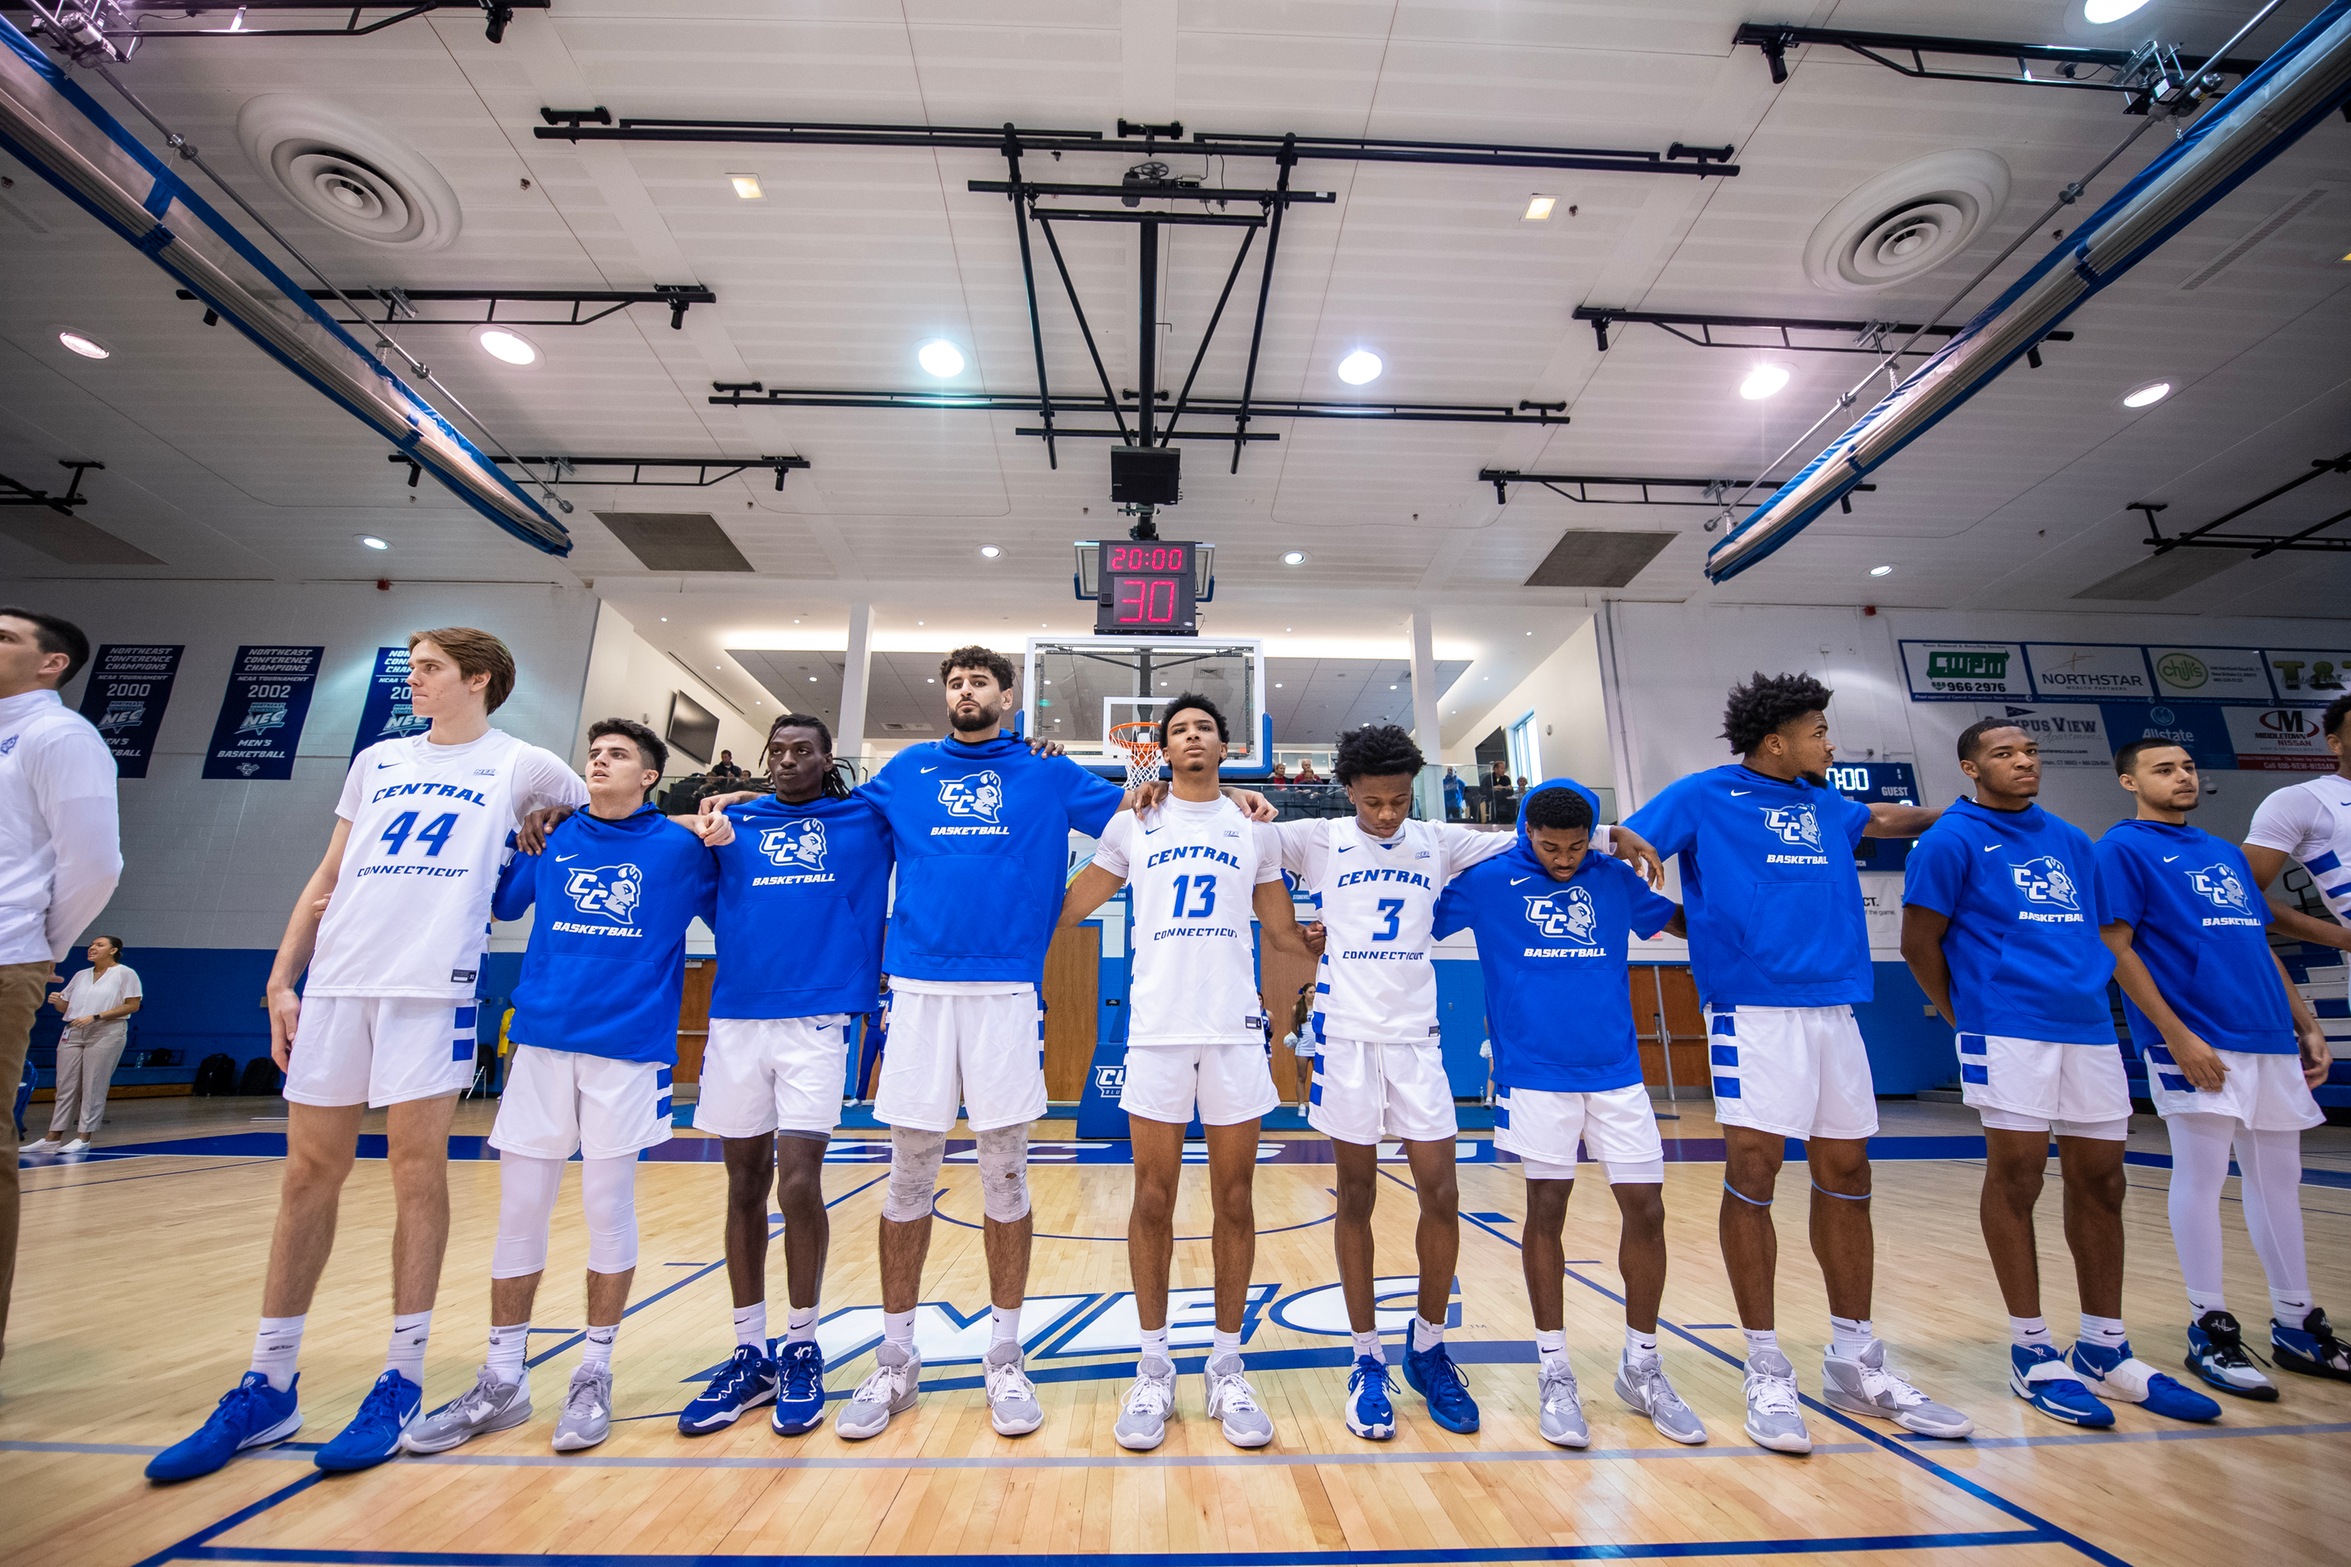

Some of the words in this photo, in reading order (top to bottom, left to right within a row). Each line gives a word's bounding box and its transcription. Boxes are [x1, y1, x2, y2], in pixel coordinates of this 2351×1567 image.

[1111, 547, 1183, 571] 20:00
[1119, 579, 1176, 623] 30
[109, 647, 173, 655] NORTHEAST
[248, 648, 313, 656] NORTHEAST
[104, 655, 173, 663] CONFERENCE
[243, 656, 313, 664] CONFERENCE
[104, 663, 168, 671] CHAMPIONS
[244, 664, 308, 672] CHAMPIONS
[2162, 659, 2203, 681] chili's
[2041, 673, 2144, 686] NORTHSTAR
[2272, 660, 2351, 691] T&
[106, 683, 151, 697] 2000
[247, 684, 292, 699] 2002
[390, 686, 413, 700] 20
[99, 709, 145, 725] NEC
[241, 710, 285, 728] NEC
[2142, 728, 2195, 742] Allstate
[104, 738, 130, 746] EN'S
[237, 739, 273, 747] MEN'S
[2277, 739, 2312, 747] NISSAN
[110, 749, 142, 757] TBALL
[216, 750, 285, 758] BASKETBALL
[371, 782, 486, 807] CENTRAL
[1881, 786, 1908, 797] GUEST
[379, 809, 461, 859] 44
[930, 826, 1010, 836] BASKETBALL
[1147, 845, 1241, 870] CENTRAL
[1766, 854, 1829, 865] BASKETBAL
[356, 865, 469, 878] CONNECTICUT
[752, 873, 836, 887] BASKETBALL
[1337, 868, 1431, 891] CENTRAL
[1171, 873, 1218, 919] 13
[1371, 897, 1407, 943] 3
[551, 921, 643, 938] BASKETBALL
[1342, 950, 1425, 961] CONNECTICUT
[1523, 947, 1607, 958] BASKETBALL
